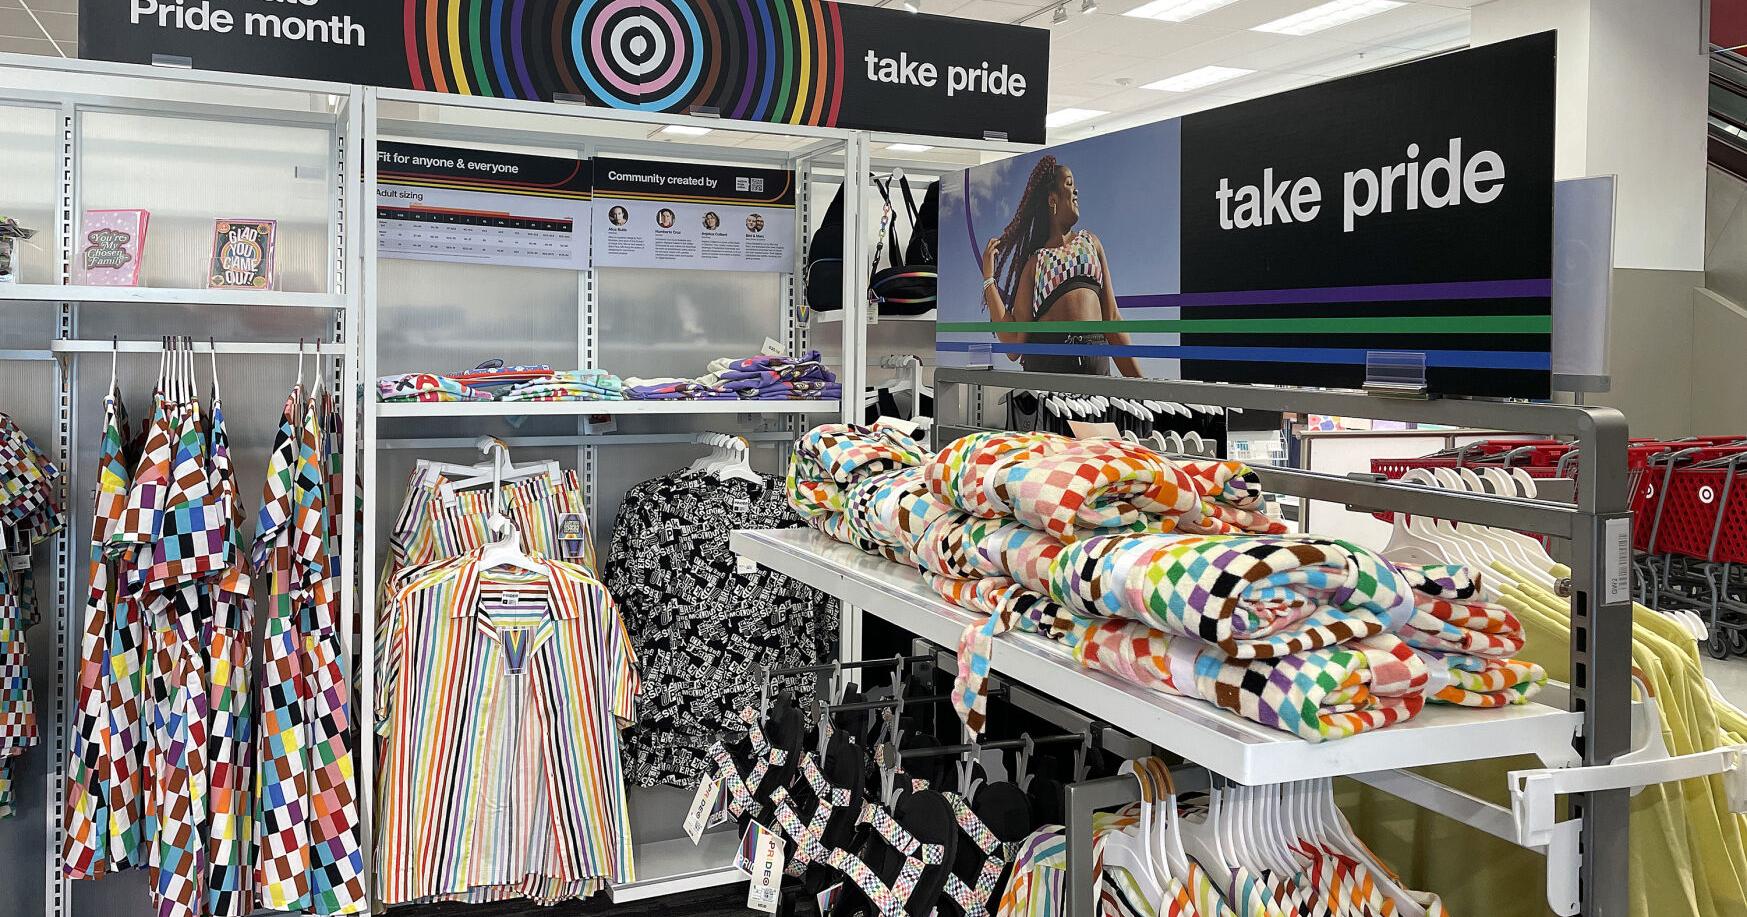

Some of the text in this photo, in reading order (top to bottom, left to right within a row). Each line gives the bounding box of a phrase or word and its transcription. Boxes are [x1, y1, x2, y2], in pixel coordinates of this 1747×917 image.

[130, 0, 366, 47] Pride month
[864, 49, 1027, 97] take pride
[377, 151, 519, 174] Fit for anyone & everyone
[607, 170, 718, 189] Community created by
[1215, 137, 1506, 232] take pride
[377, 188, 424, 202] Adult sizing
[228, 226, 258, 244] GLAD
[230, 242, 254, 258] YOU
[223, 255, 259, 272] CAME
[225, 270, 255, 285] OUT!
